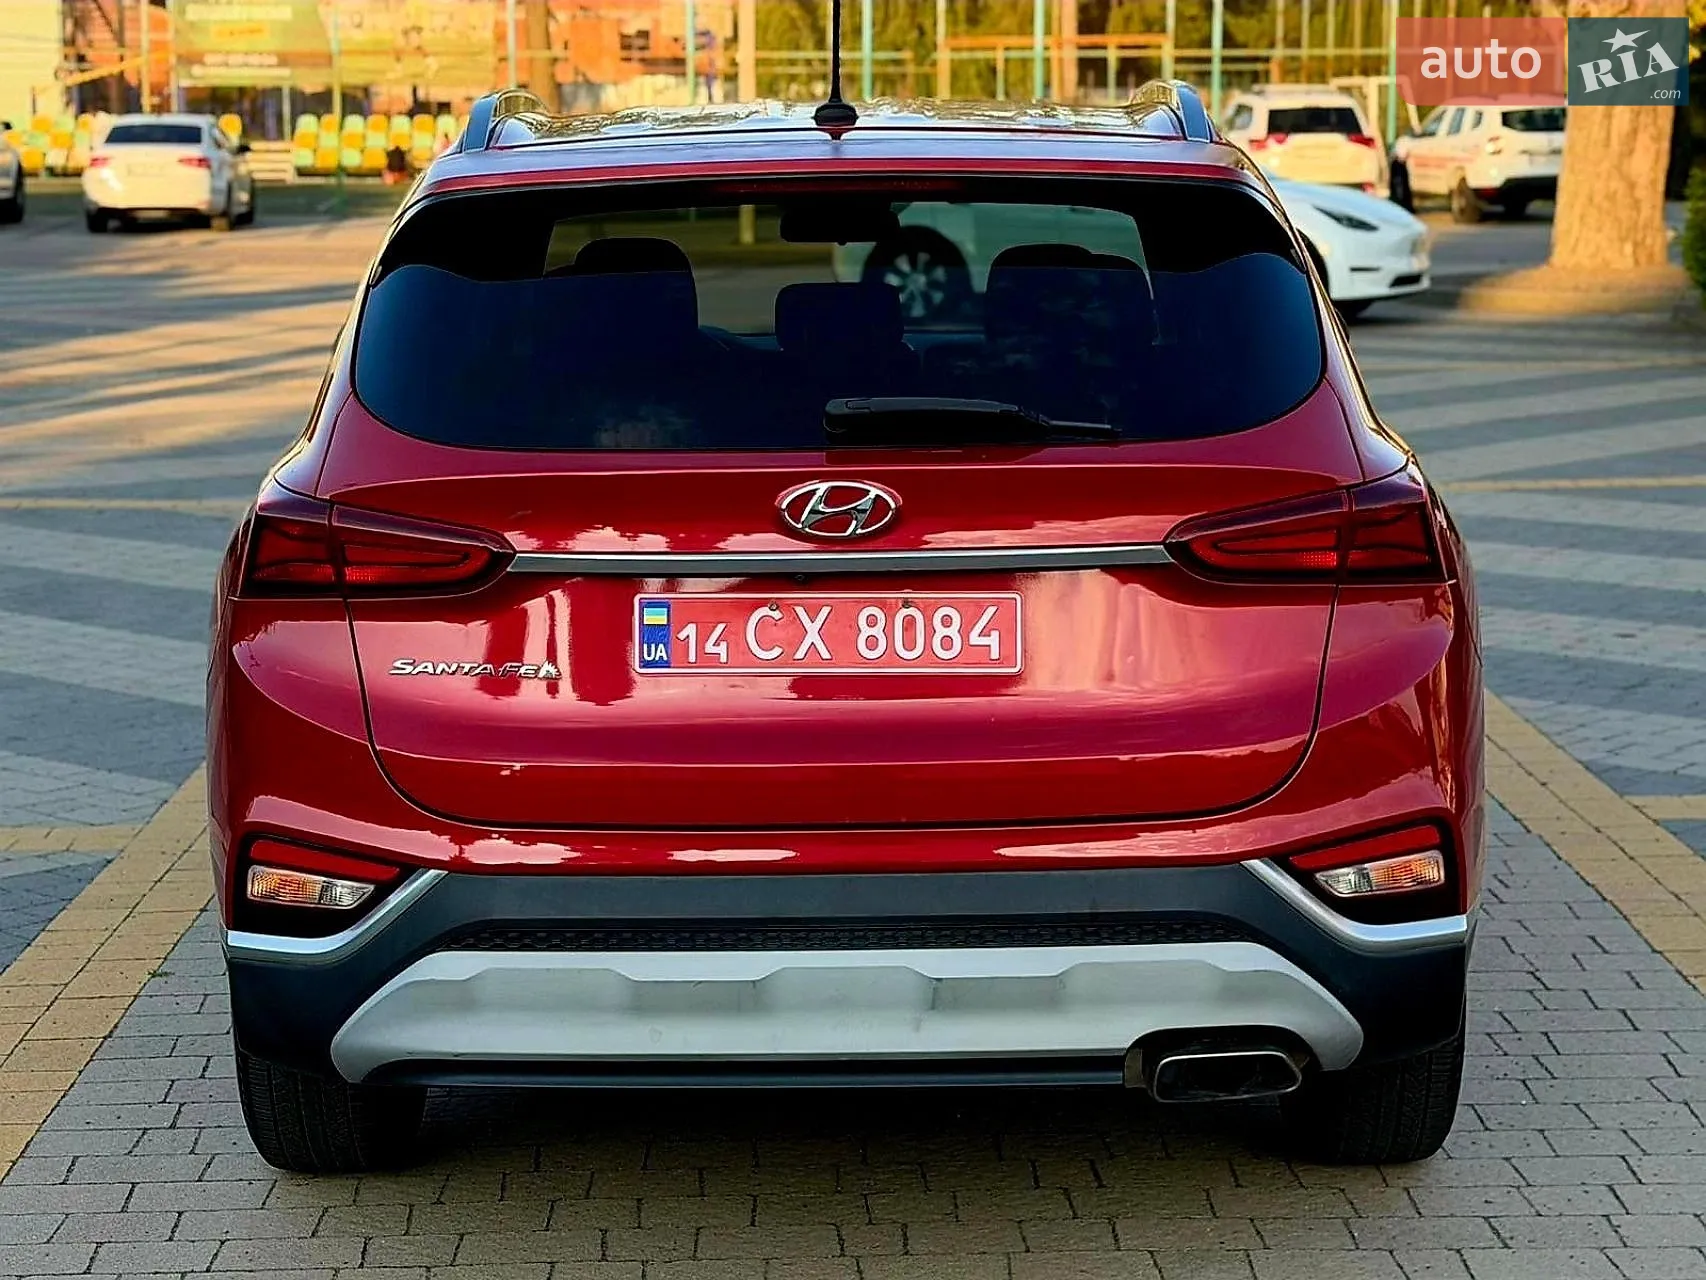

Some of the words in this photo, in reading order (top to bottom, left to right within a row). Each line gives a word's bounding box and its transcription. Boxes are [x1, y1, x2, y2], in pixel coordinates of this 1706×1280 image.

[643, 642, 668, 662] UA
[676, 622, 729, 664] 14
[745, 605, 833, 661] CX
[856, 605, 1001, 661] 8084
